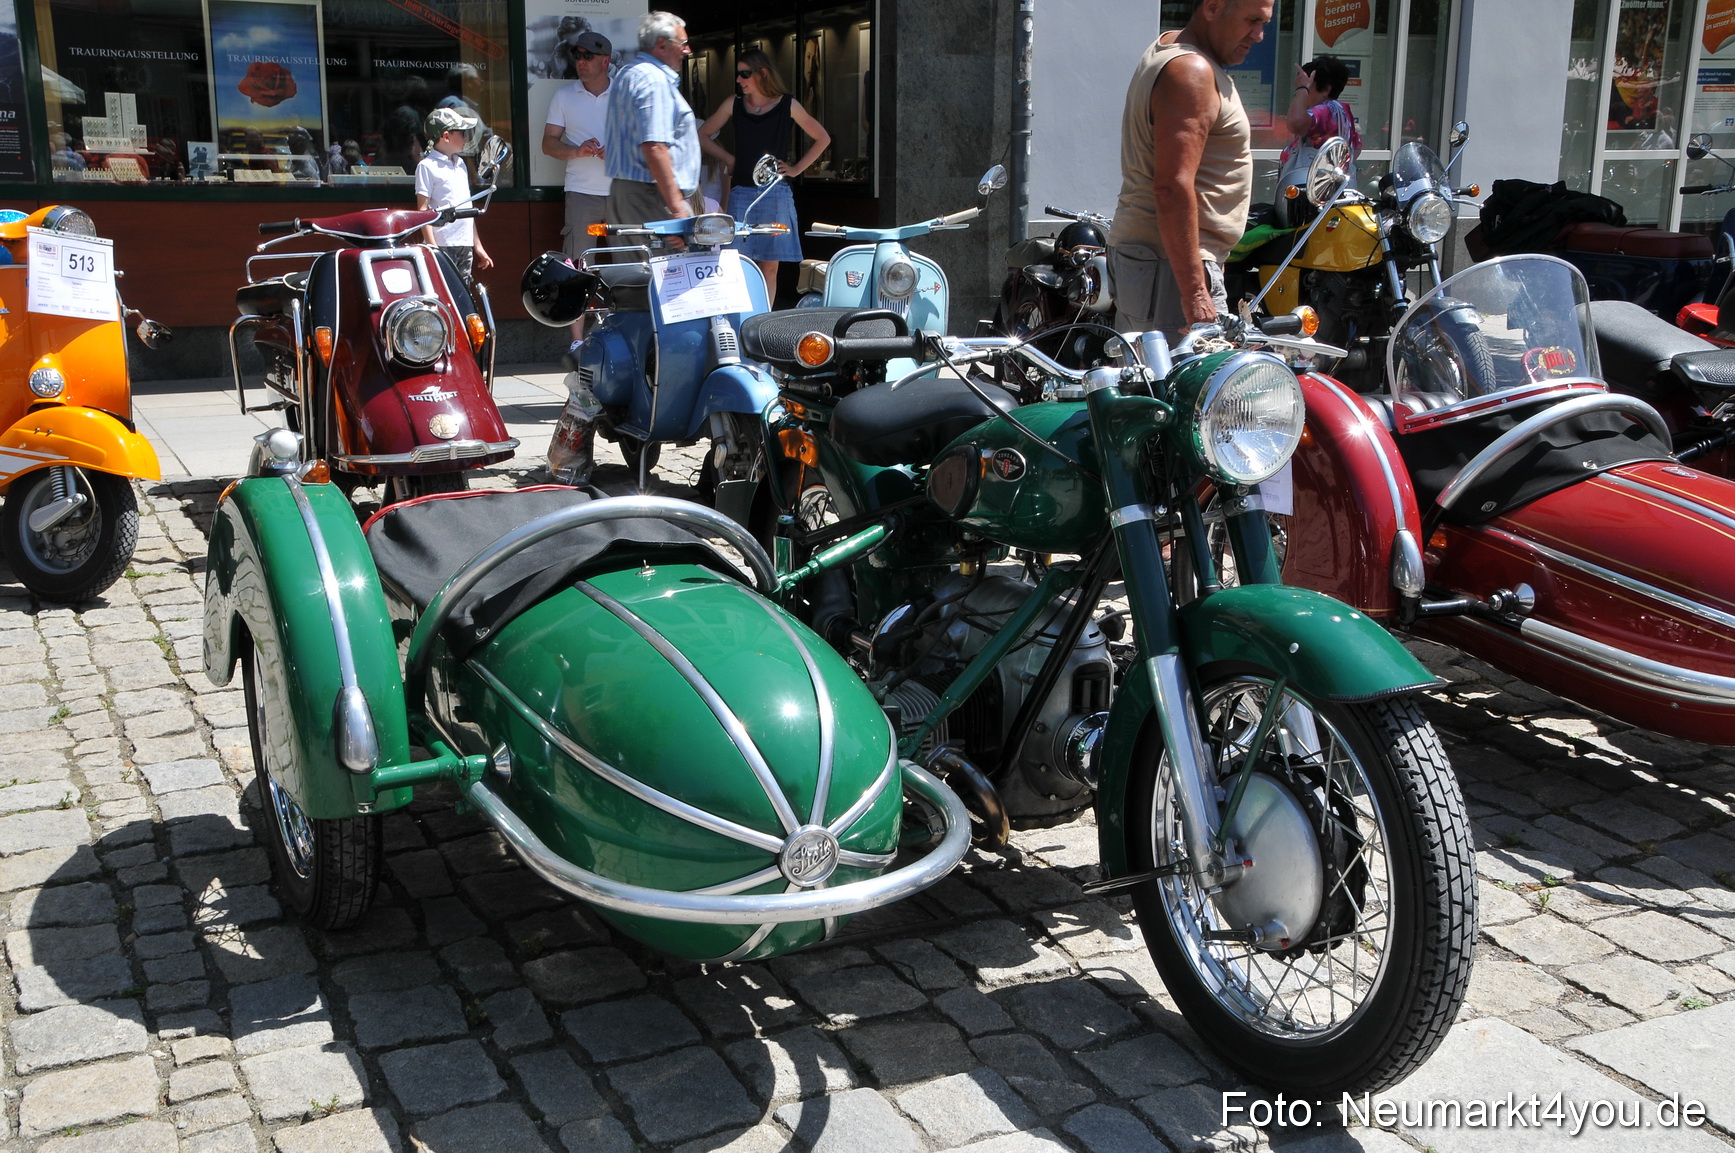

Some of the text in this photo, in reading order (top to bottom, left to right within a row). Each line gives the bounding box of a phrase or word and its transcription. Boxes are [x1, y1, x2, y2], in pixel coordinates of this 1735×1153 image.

[1325, 1, 1362, 16] beraten
[1324, 13, 1357, 29] lassen!
[68, 46, 199, 61] TRAURINGAUSSTELLUNG
[226, 53, 348, 67] TRAURINGAUSSTELUNG
[68, 253, 95, 273] 513
[694, 264, 724, 280] 620
